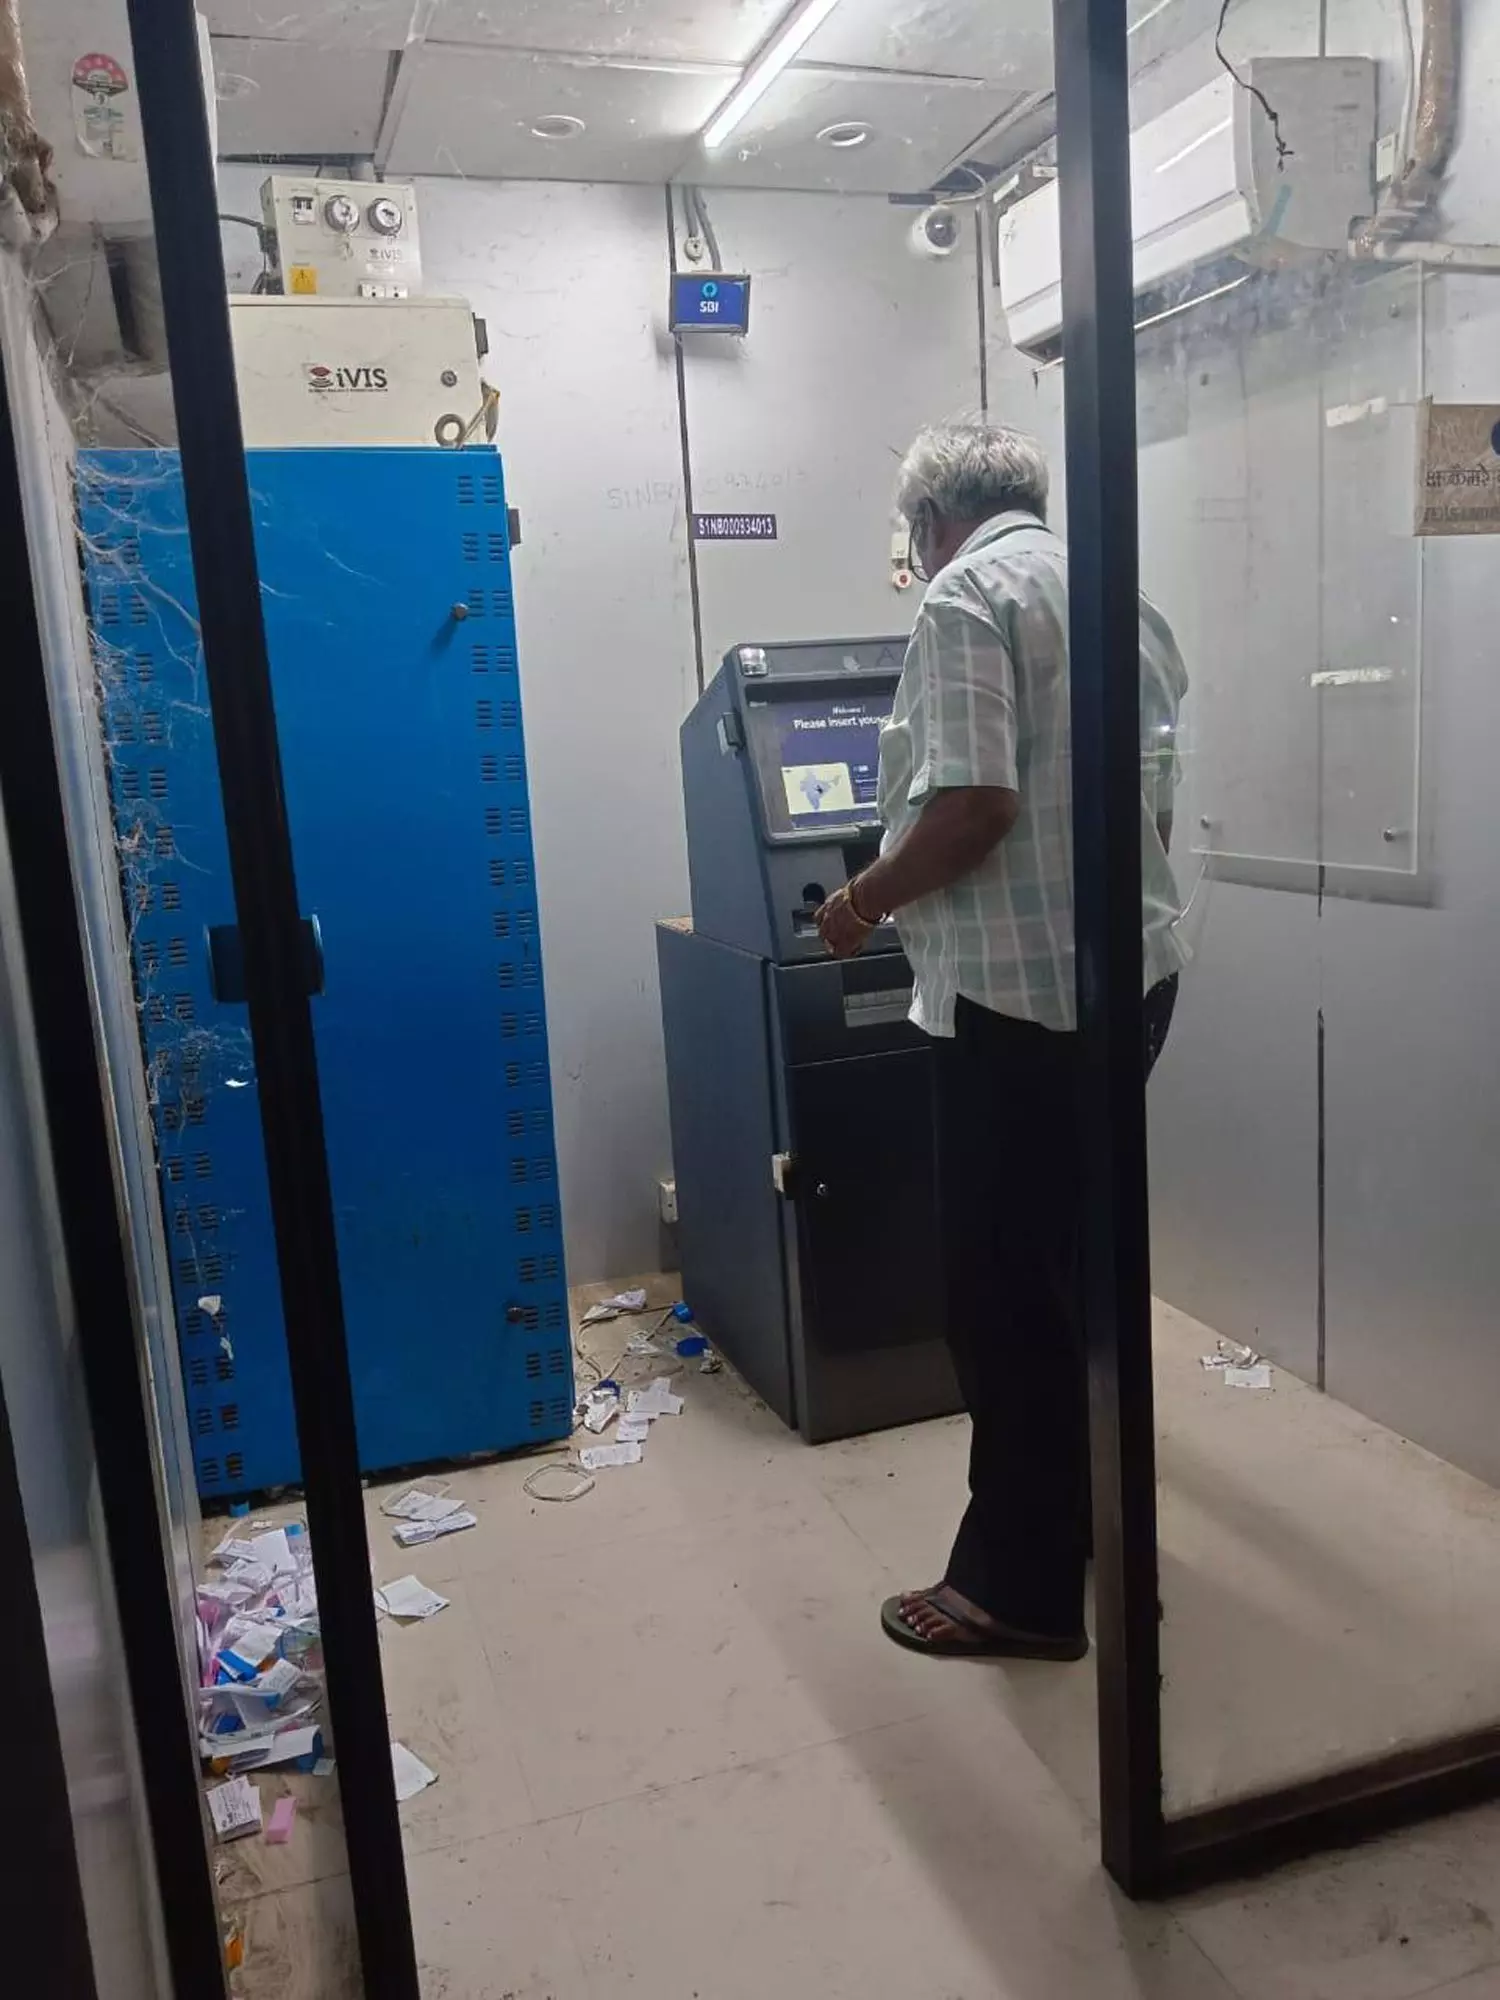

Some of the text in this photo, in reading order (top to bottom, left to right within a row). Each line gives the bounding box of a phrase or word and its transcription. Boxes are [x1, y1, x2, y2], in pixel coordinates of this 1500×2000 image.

[699, 300, 719, 313] SBI
[336, 367, 388, 388] iVIS
[793, 719, 826, 730] Please
[827, 716, 858, 727] insert
